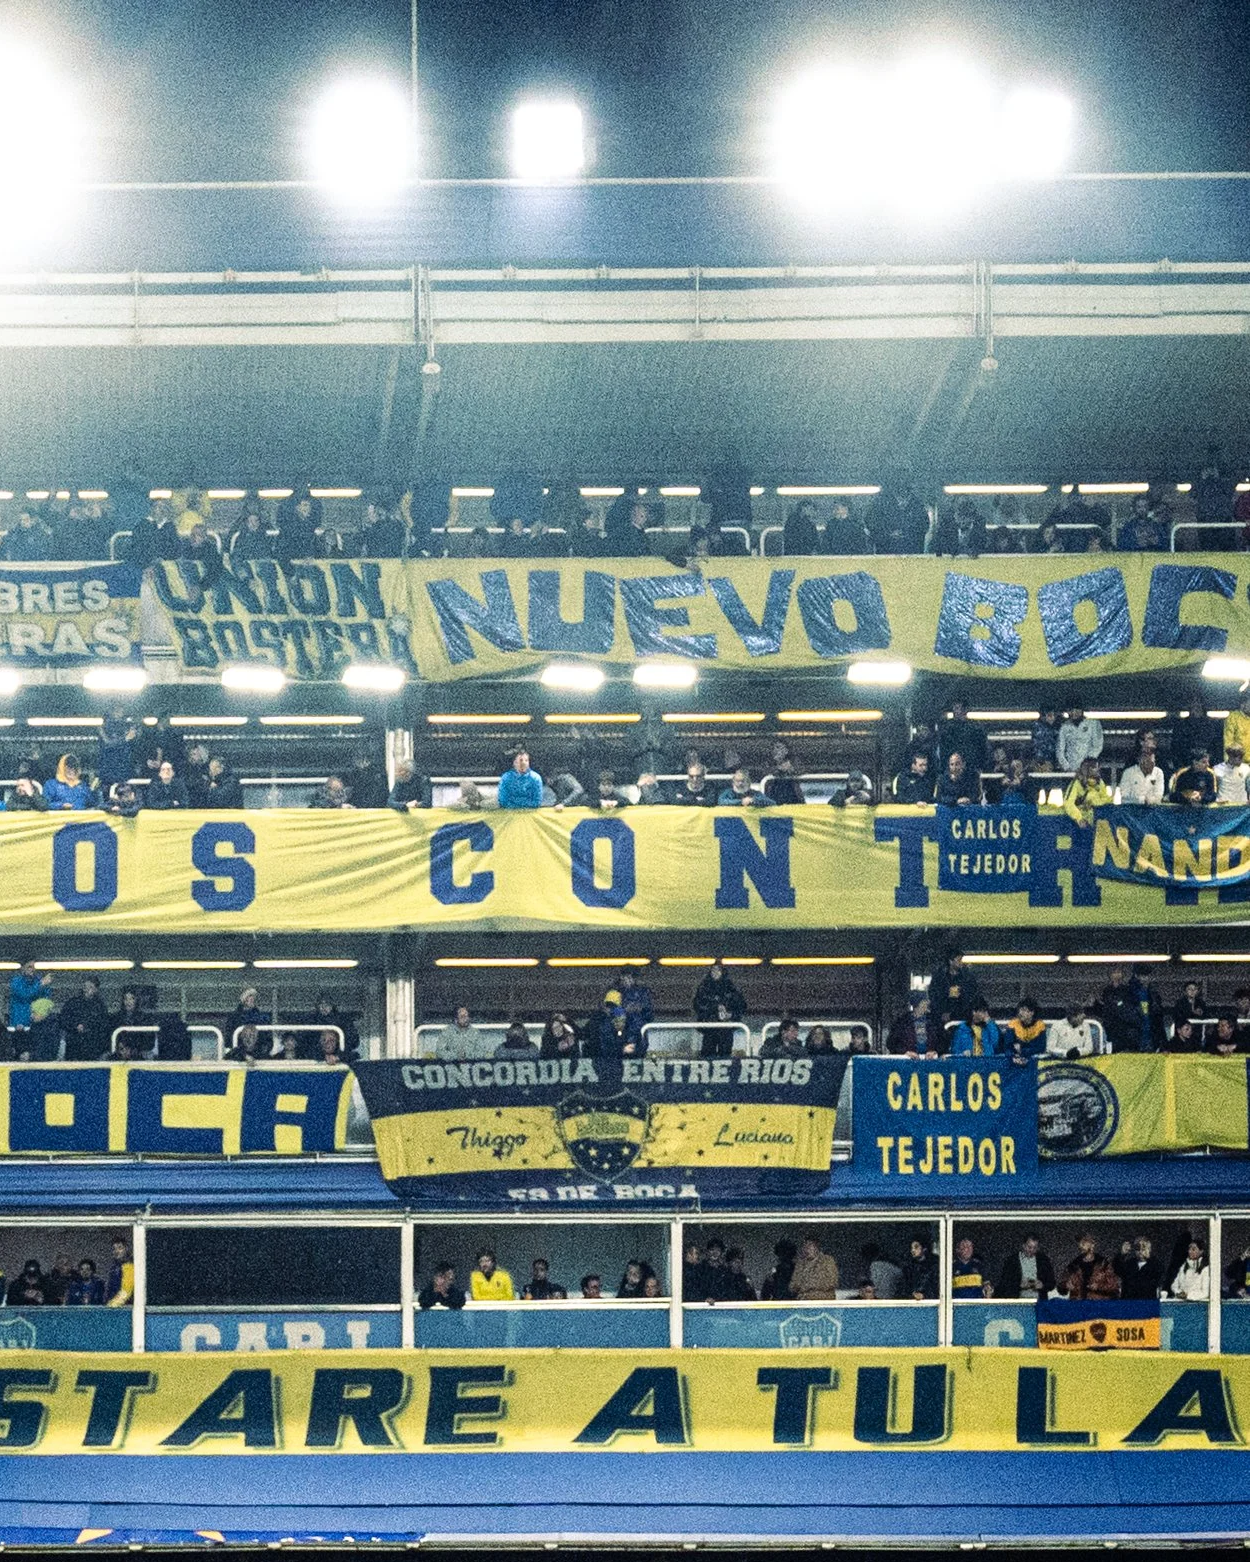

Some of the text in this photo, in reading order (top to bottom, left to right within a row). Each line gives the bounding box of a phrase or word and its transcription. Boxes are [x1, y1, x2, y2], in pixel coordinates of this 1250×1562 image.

[154, 557, 386, 620] UNION
[425, 564, 1250, 669] NUEVO BOC
[951, 818, 1022, 840] CARLOS
[428, 815, 1250, 909] CONTR
[948, 852, 1032, 876] TEJEDOR
[401, 1057, 813, 1091] CONCORDIA ENTRE RIOS
[886, 1070, 1003, 1112] CARLOS
[876, 1136, 1017, 1176] TEJEDOR
[1039, 1329, 1087, 1345] MARTINEZ
[1116, 1327, 1146, 1342] SOSA
[571, 1366, 693, 1447] A
